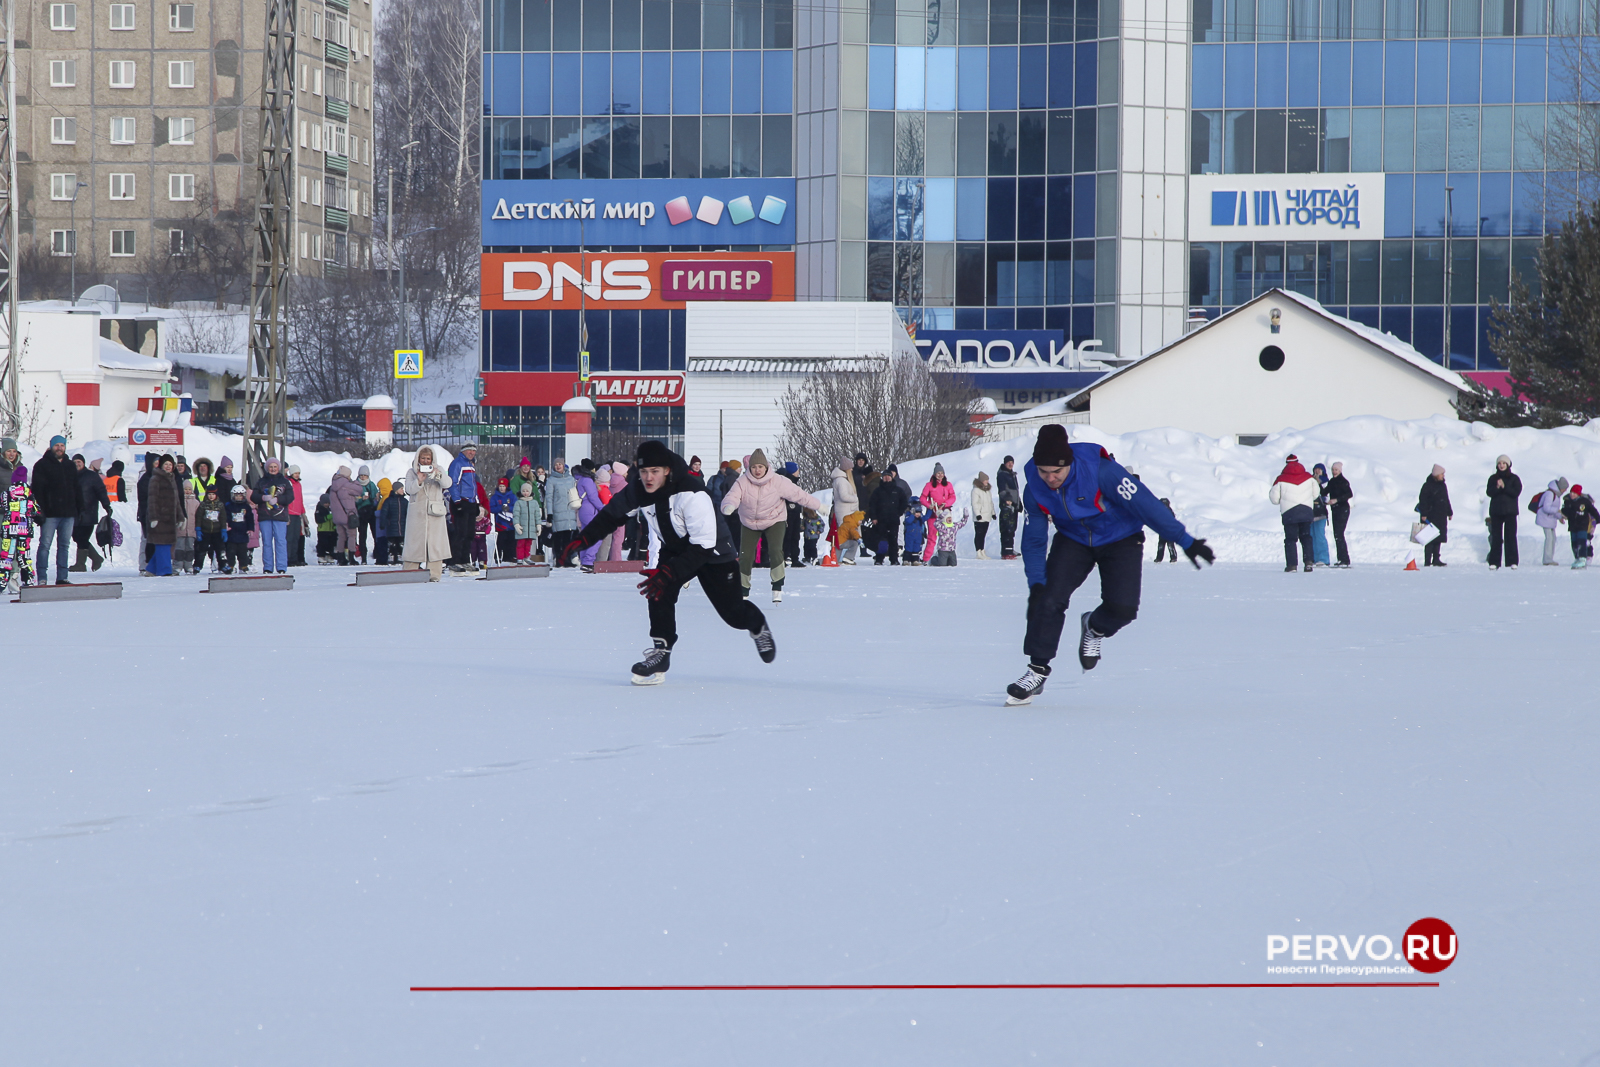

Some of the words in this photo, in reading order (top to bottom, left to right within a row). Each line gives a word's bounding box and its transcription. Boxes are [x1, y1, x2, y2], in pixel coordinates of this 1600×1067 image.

[1286, 183, 1359, 207] ЧИТАЙ
[491, 198, 596, 220] Детский
[603, 201, 655, 226] мир
[1286, 206, 1360, 229] ГОРОД
[503, 259, 652, 301] DNS
[672, 270, 761, 291] ГИПЕР
[587, 379, 680, 395] МАГНИТ
[636, 397, 643, 405] у
[645, 395, 668, 403] дома
[1117, 477, 1138, 501] 88
